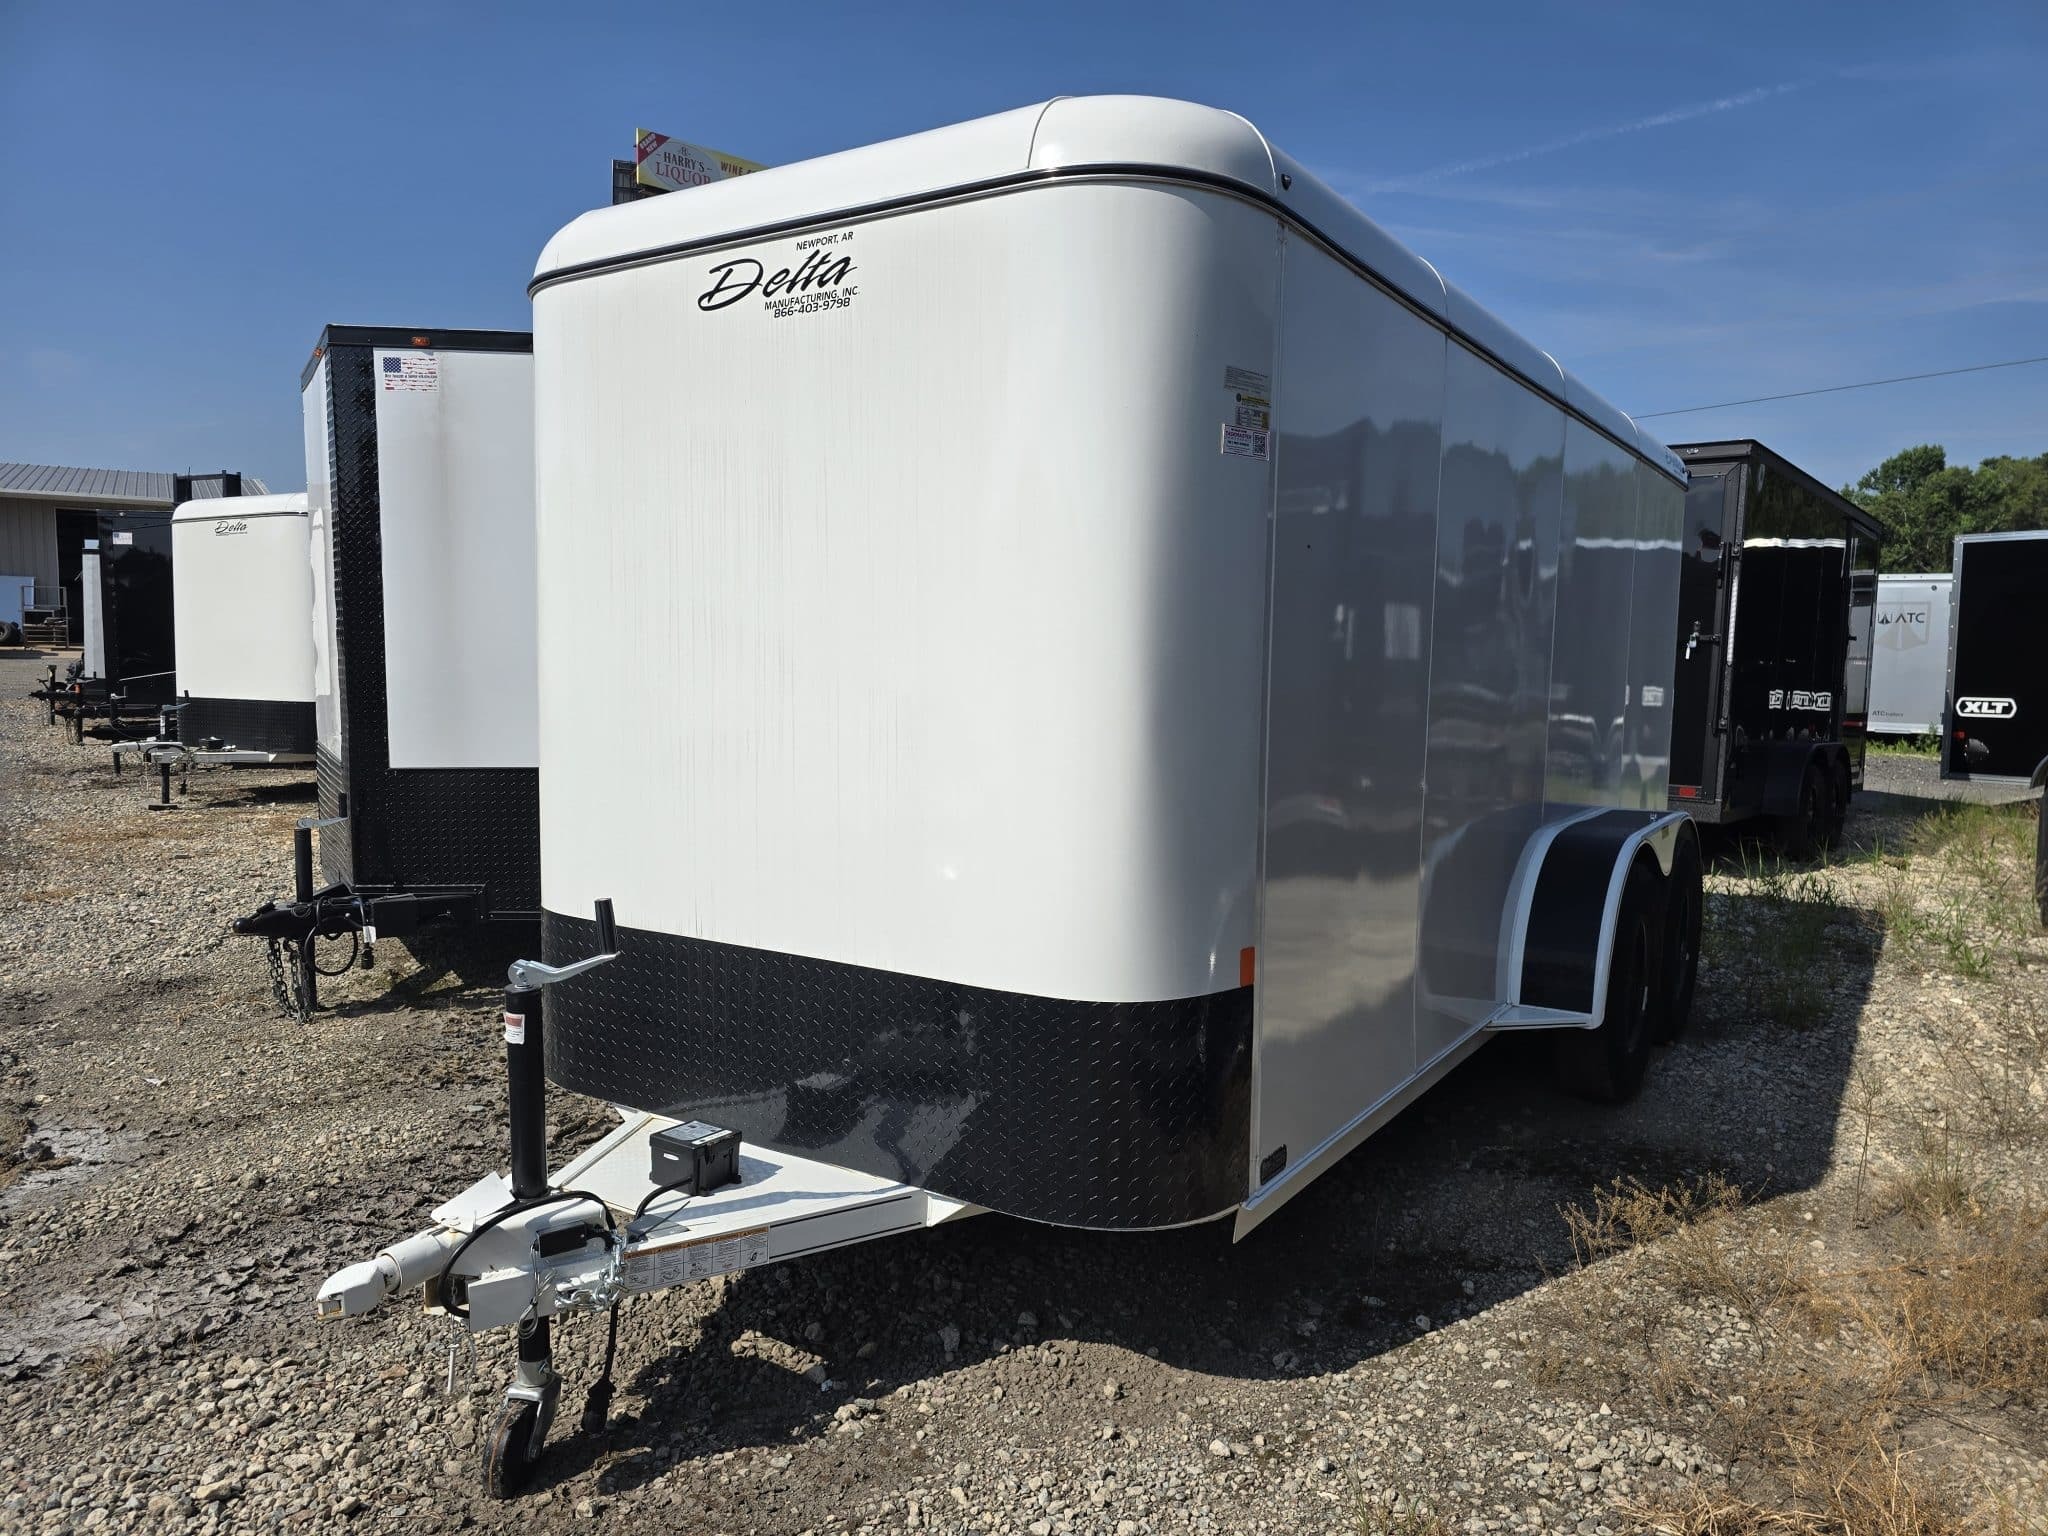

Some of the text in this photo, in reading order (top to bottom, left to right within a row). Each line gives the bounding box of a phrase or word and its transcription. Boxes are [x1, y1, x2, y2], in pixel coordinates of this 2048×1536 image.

[663, 151, 705, 172] HARRY'S
[796, 231, 854, 251] NEWPORT, AR
[697, 249, 858, 311] Delta
[764, 289, 840, 311] MANUFACTURING,
[774, 297, 851, 318] 866-403-9798
[214, 520, 248, 534] Delta
[1895, 611, 1926, 624] ATC
[1963, 701, 2009, 714] XLT
